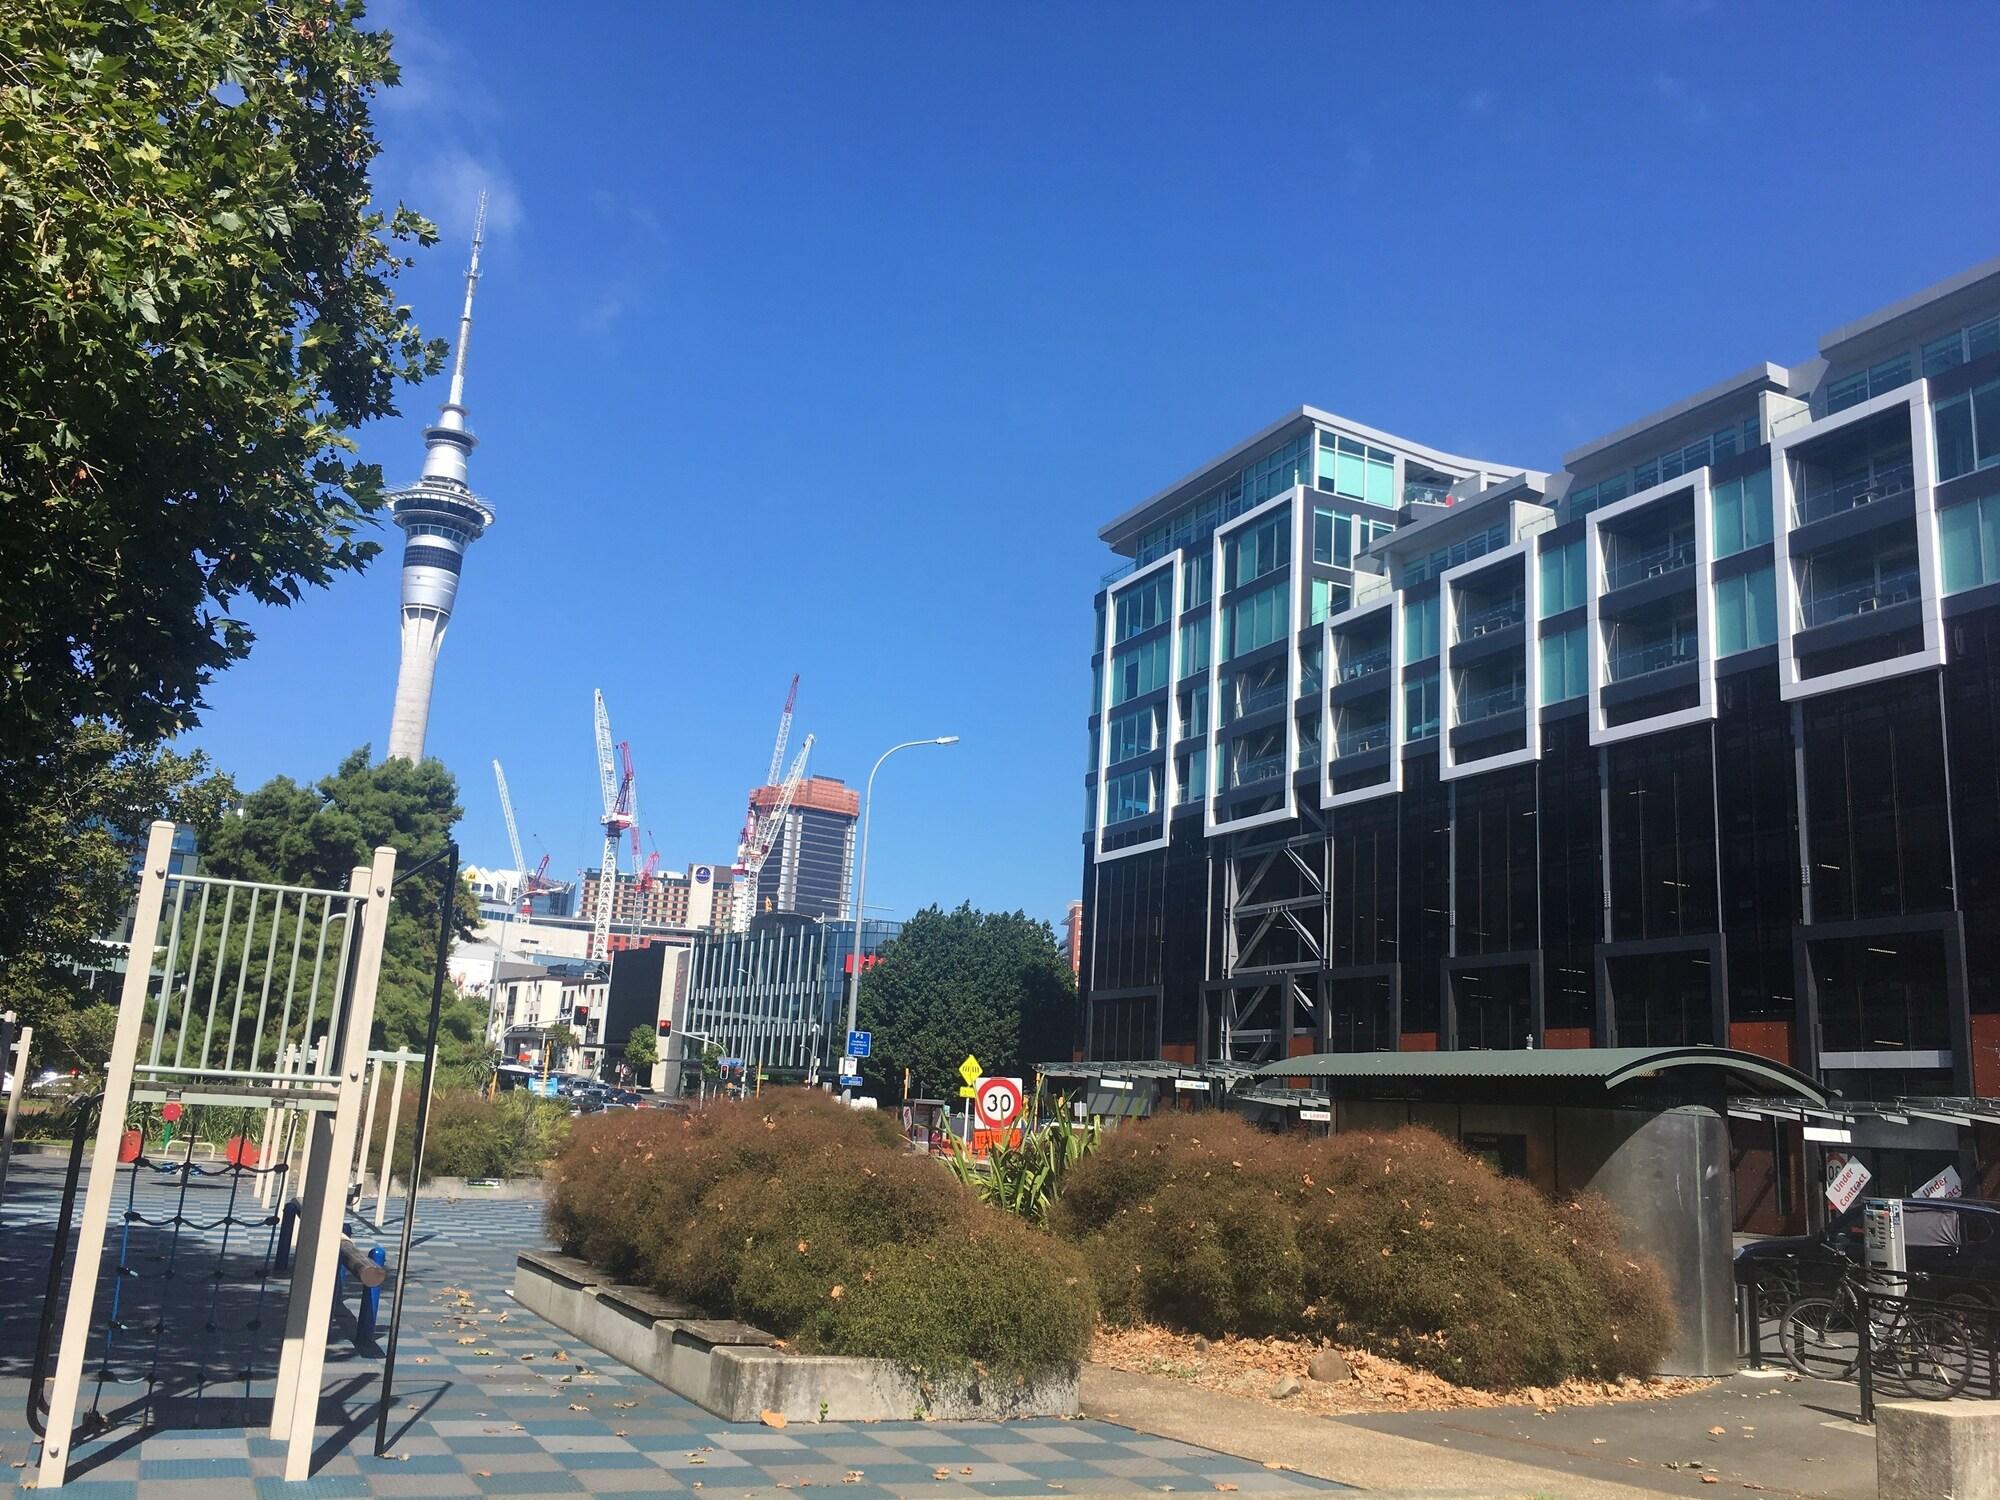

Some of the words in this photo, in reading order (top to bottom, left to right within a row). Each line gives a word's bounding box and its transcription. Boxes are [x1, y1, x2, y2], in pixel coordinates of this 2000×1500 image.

[987, 1094, 1011, 1112] 30
[1834, 1168, 1854, 1192] Under
[1840, 1173, 1867, 1206] Contract
[1923, 1176, 1947, 1198] Under
